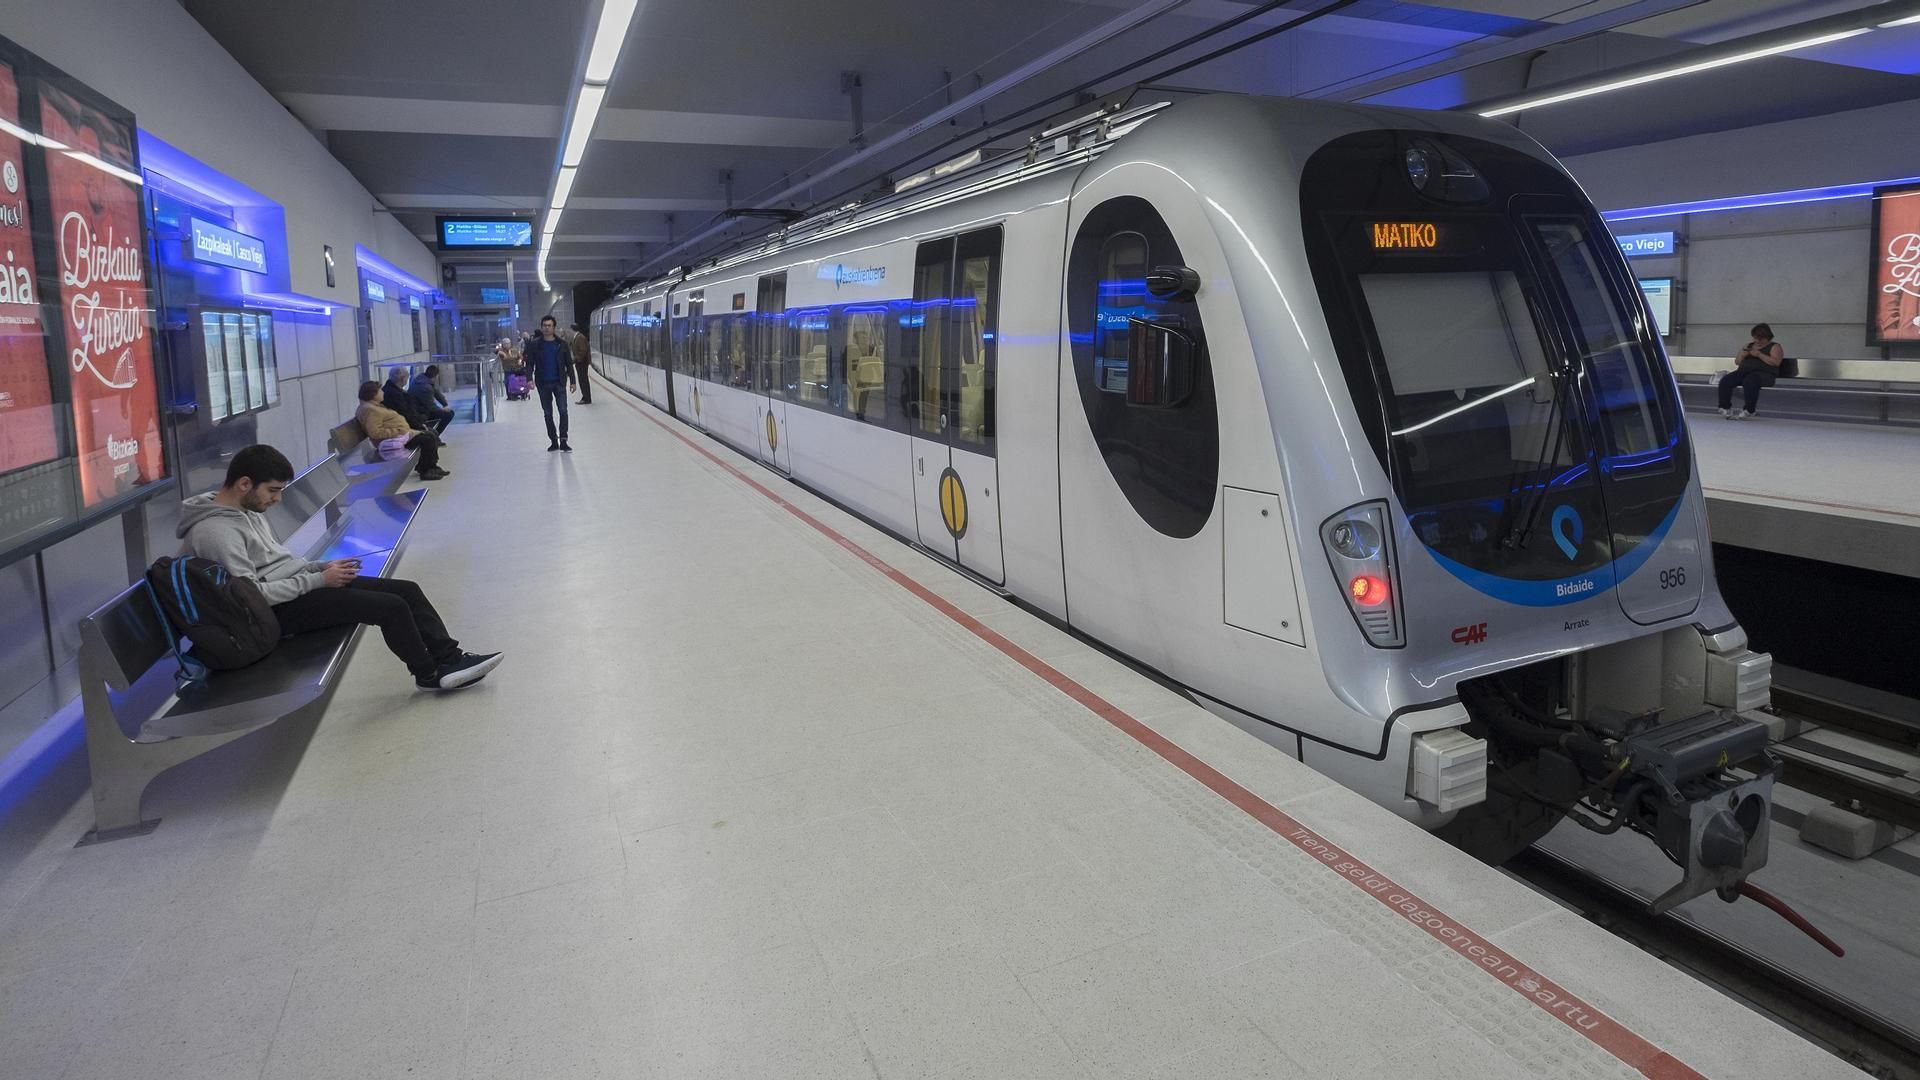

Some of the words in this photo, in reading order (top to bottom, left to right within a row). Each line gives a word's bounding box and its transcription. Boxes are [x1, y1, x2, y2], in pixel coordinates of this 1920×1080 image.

[1374, 223, 1437, 248] MATIKO
[1636, 238, 1665, 252] Viejo
[61, 211, 141, 289] Bizkaia
[71, 290, 143, 373] Zurekin
[1556, 579, 1594, 597] Bidaide
[1659, 566, 1686, 590] 956
[1451, 622, 1488, 645] CAF
[1563, 618, 1590, 632] Arrate
[1290, 828, 1339, 861] Trena
[1334, 862, 1393, 893] geldi
[1388, 894, 1518, 978] dagoenean
